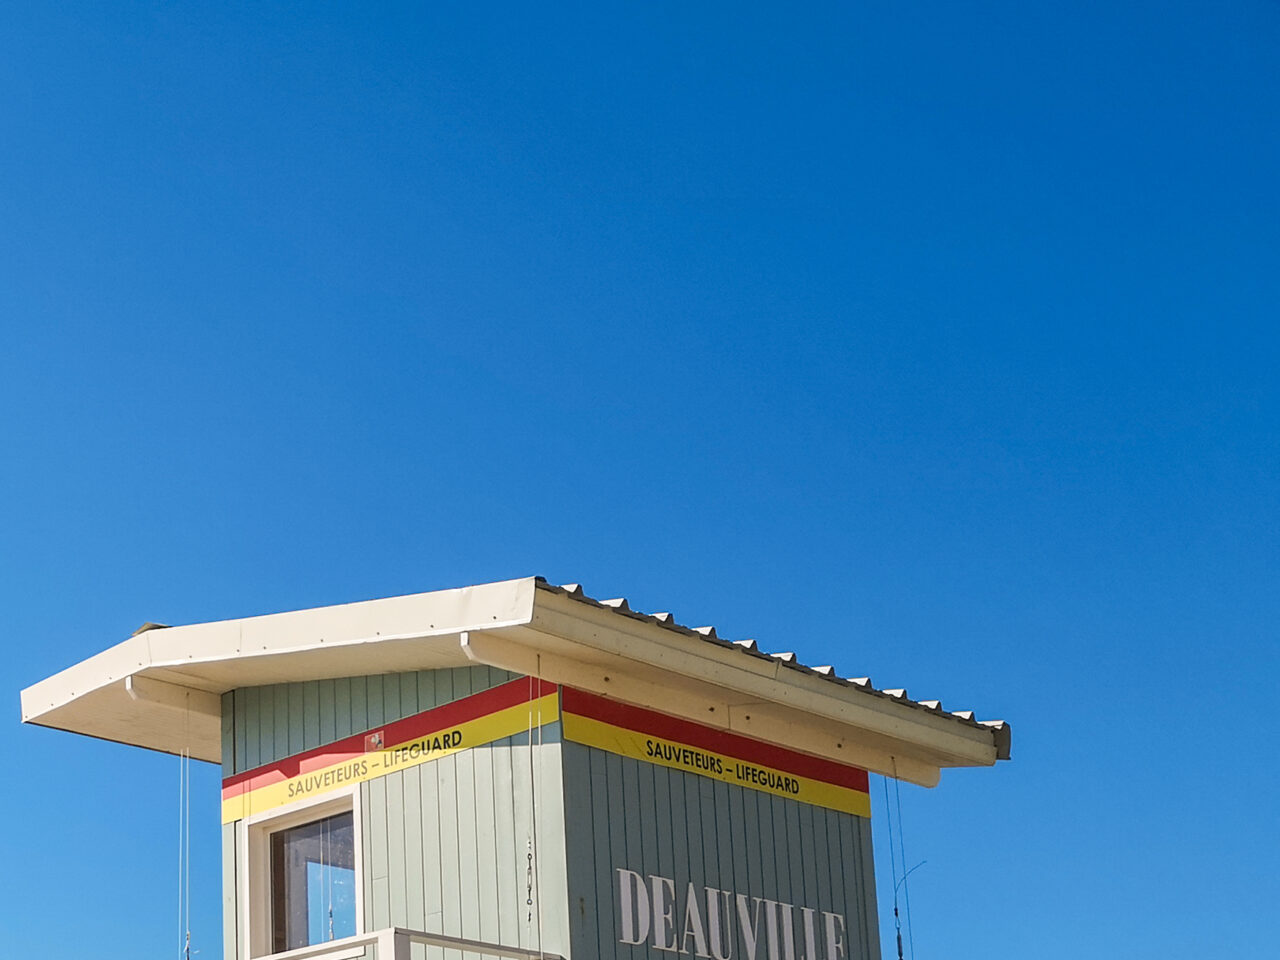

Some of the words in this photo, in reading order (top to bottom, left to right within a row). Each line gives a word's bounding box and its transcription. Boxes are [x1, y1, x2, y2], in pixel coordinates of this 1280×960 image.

[287, 760, 368, 798] SAUVETEURS
[383, 730, 463, 769] LIFEGUARD
[646, 739, 723, 775] SAUVETEURS
[736, 763, 800, 794] LIFEGUARD
